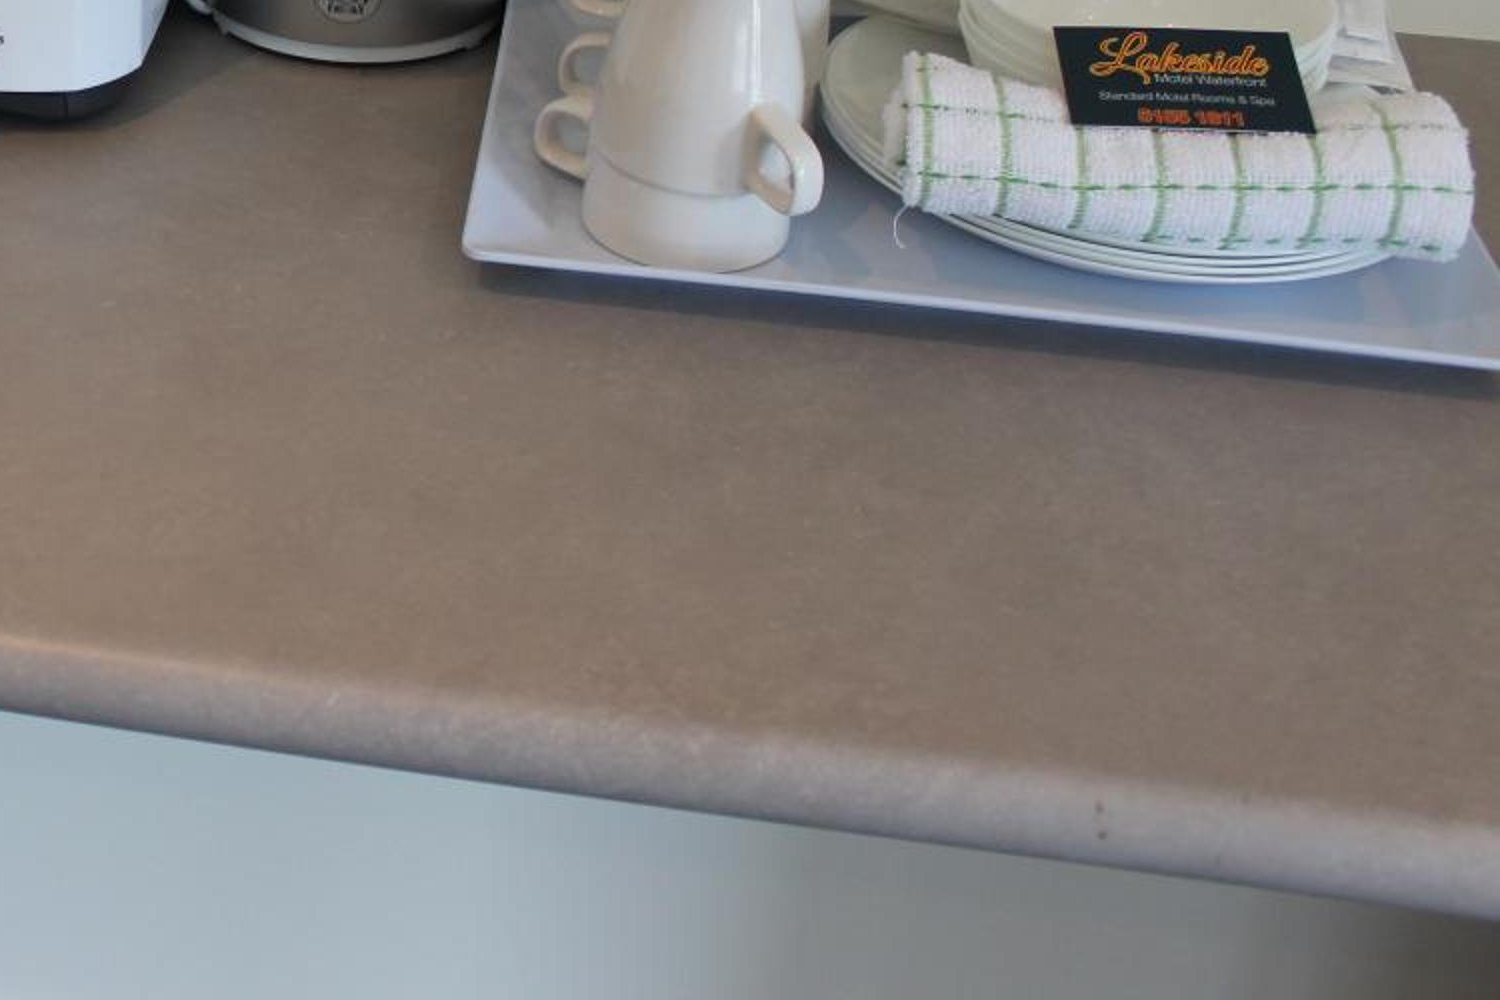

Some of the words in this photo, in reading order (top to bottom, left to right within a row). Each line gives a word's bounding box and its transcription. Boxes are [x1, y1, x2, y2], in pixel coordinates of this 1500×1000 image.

[1089, 31, 1270, 85] Lakeside
[1154, 73, 1193, 85] Motel
[1195, 74, 1268, 88] Waterfront
[1098, 91, 1153, 102] Standard
[1191, 93, 1236, 104] Rooms
[1250, 95, 1276, 107] Spa
